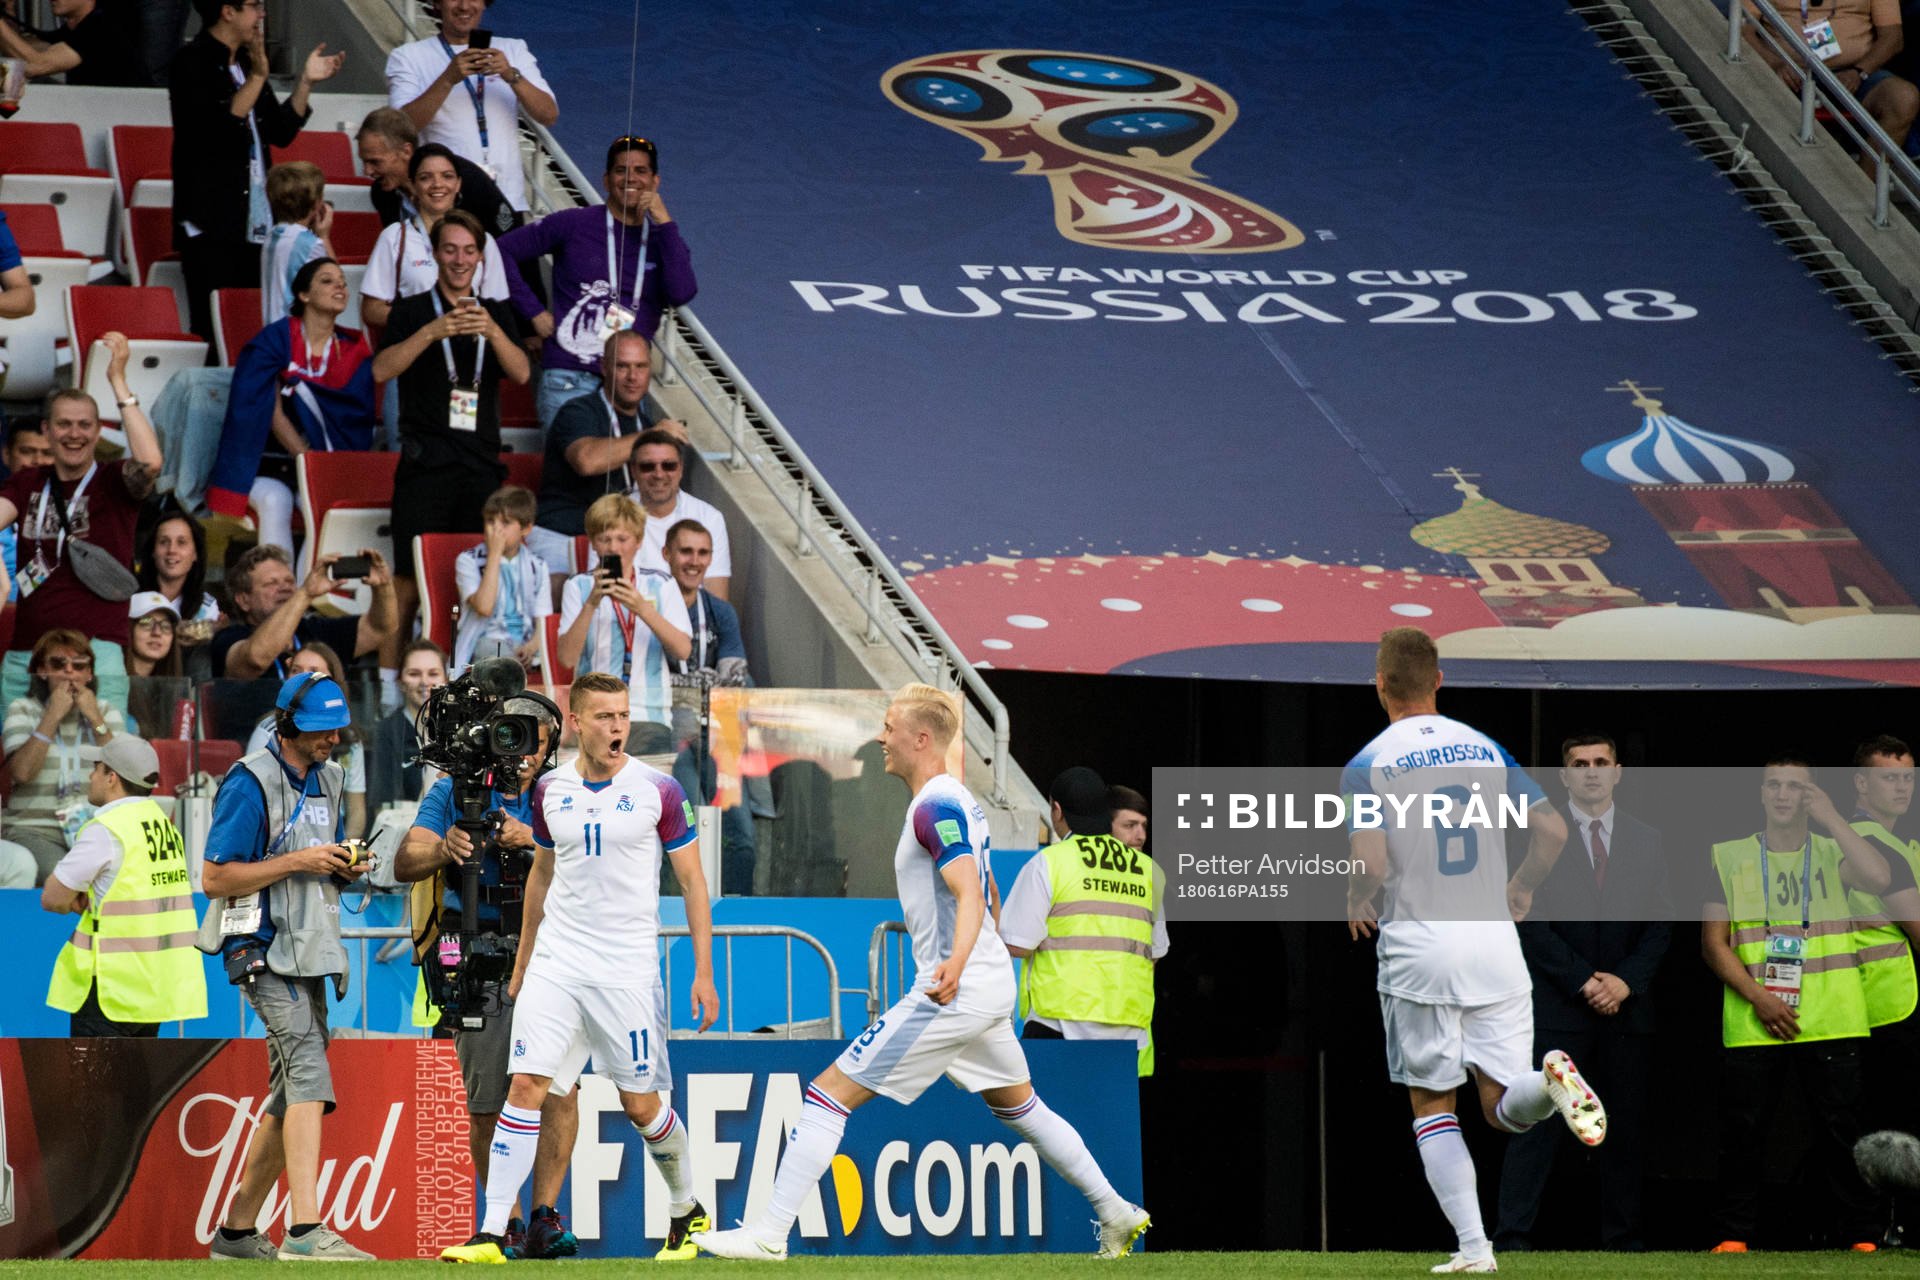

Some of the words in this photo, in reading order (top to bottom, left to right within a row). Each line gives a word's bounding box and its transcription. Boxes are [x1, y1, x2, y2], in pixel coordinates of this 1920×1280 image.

[960, 264, 1101, 283] FIFA
[1100, 267, 1337, 286] WORLD
[1347, 269, 1468, 286] CUP
[790, 279, 1346, 323] RUSSIA
[1356, 288, 1699, 323] 2018
[583, 822, 602, 857] 11
[1431, 783, 1479, 877] 6
[1075, 835, 1145, 876] 5282
[151, 869, 189, 886] STEWAR
[1082, 877, 1147, 899] STEWARD
[629, 1028, 649, 1062] 11
[415, 1040, 435, 1159] УПОТРЕБЛЕНИЕ
[435, 1041, 457, 1133] ВРЕДИТ
[415, 1165, 435, 1259] РЕЗМЕРНОЕ
[435, 1142, 454, 1259] ЛКОГОЛЯ
